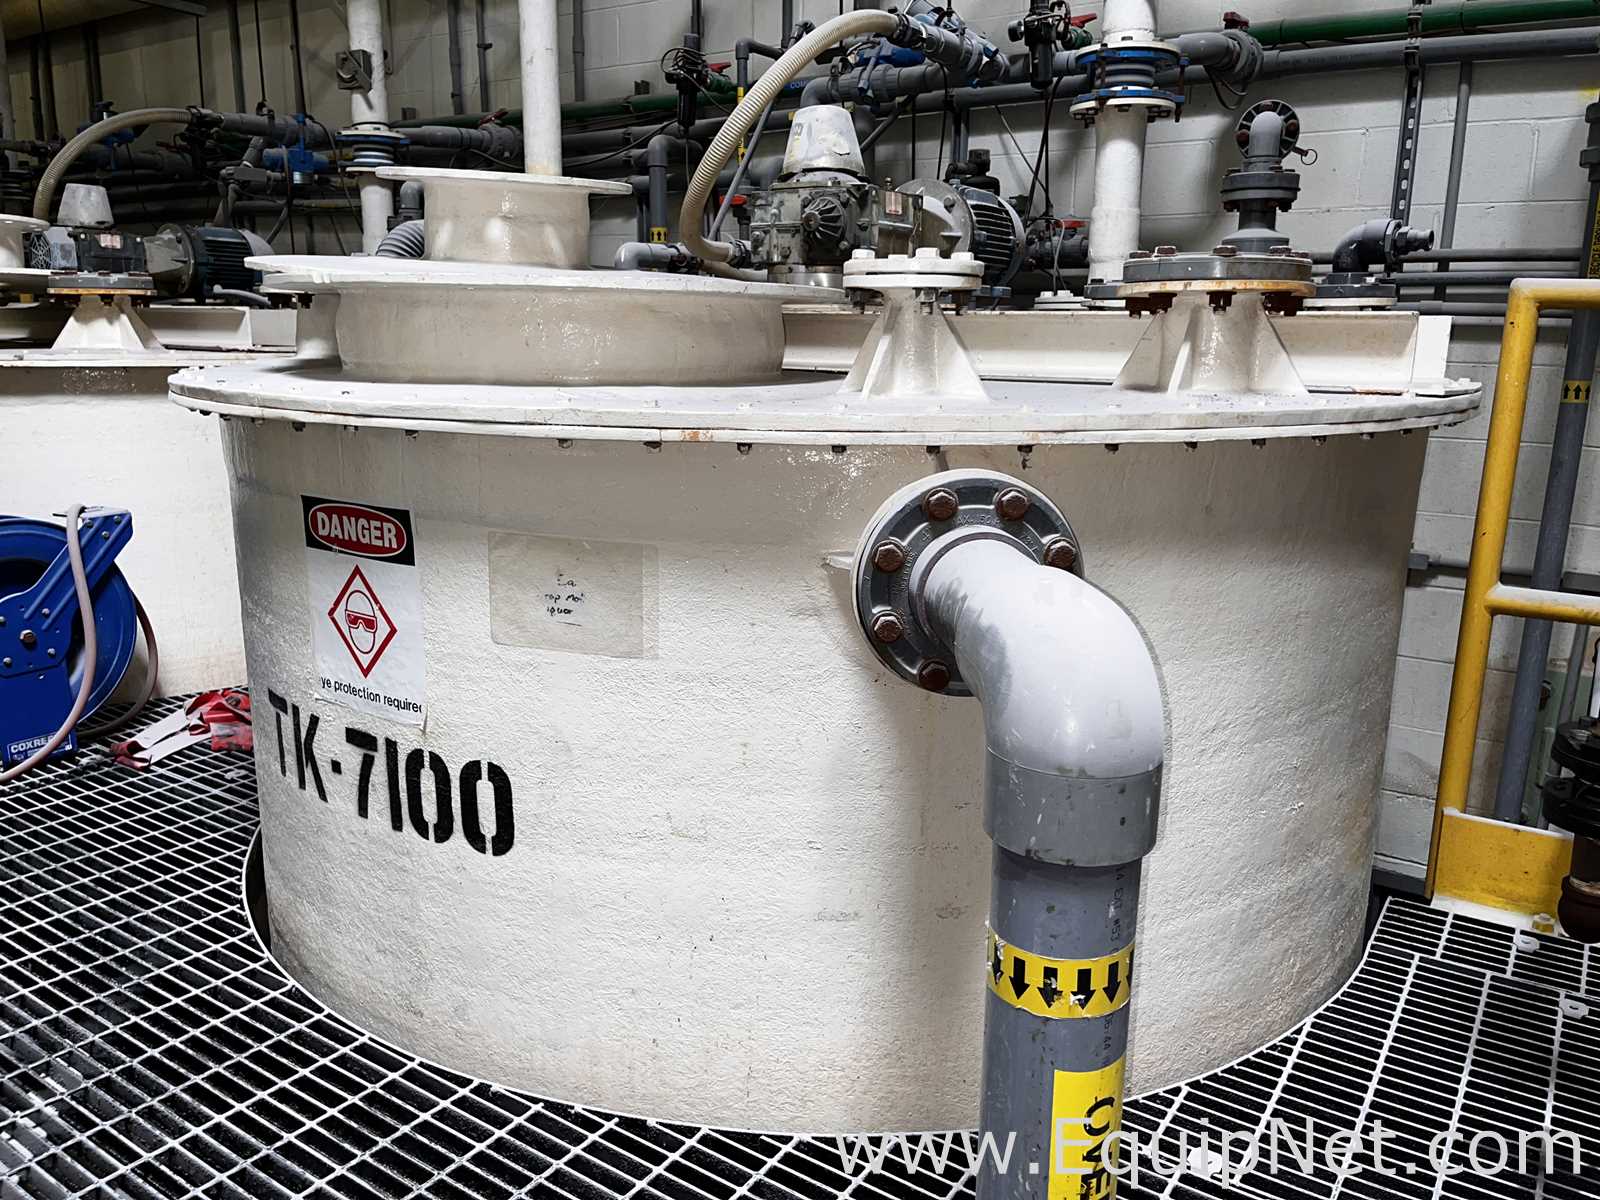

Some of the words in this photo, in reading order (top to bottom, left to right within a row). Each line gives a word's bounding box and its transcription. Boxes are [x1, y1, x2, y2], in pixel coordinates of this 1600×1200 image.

[315, 511, 399, 550] DANGER
[334, 680, 381, 704] protection
[267, 687, 516, 858] TK-7100
